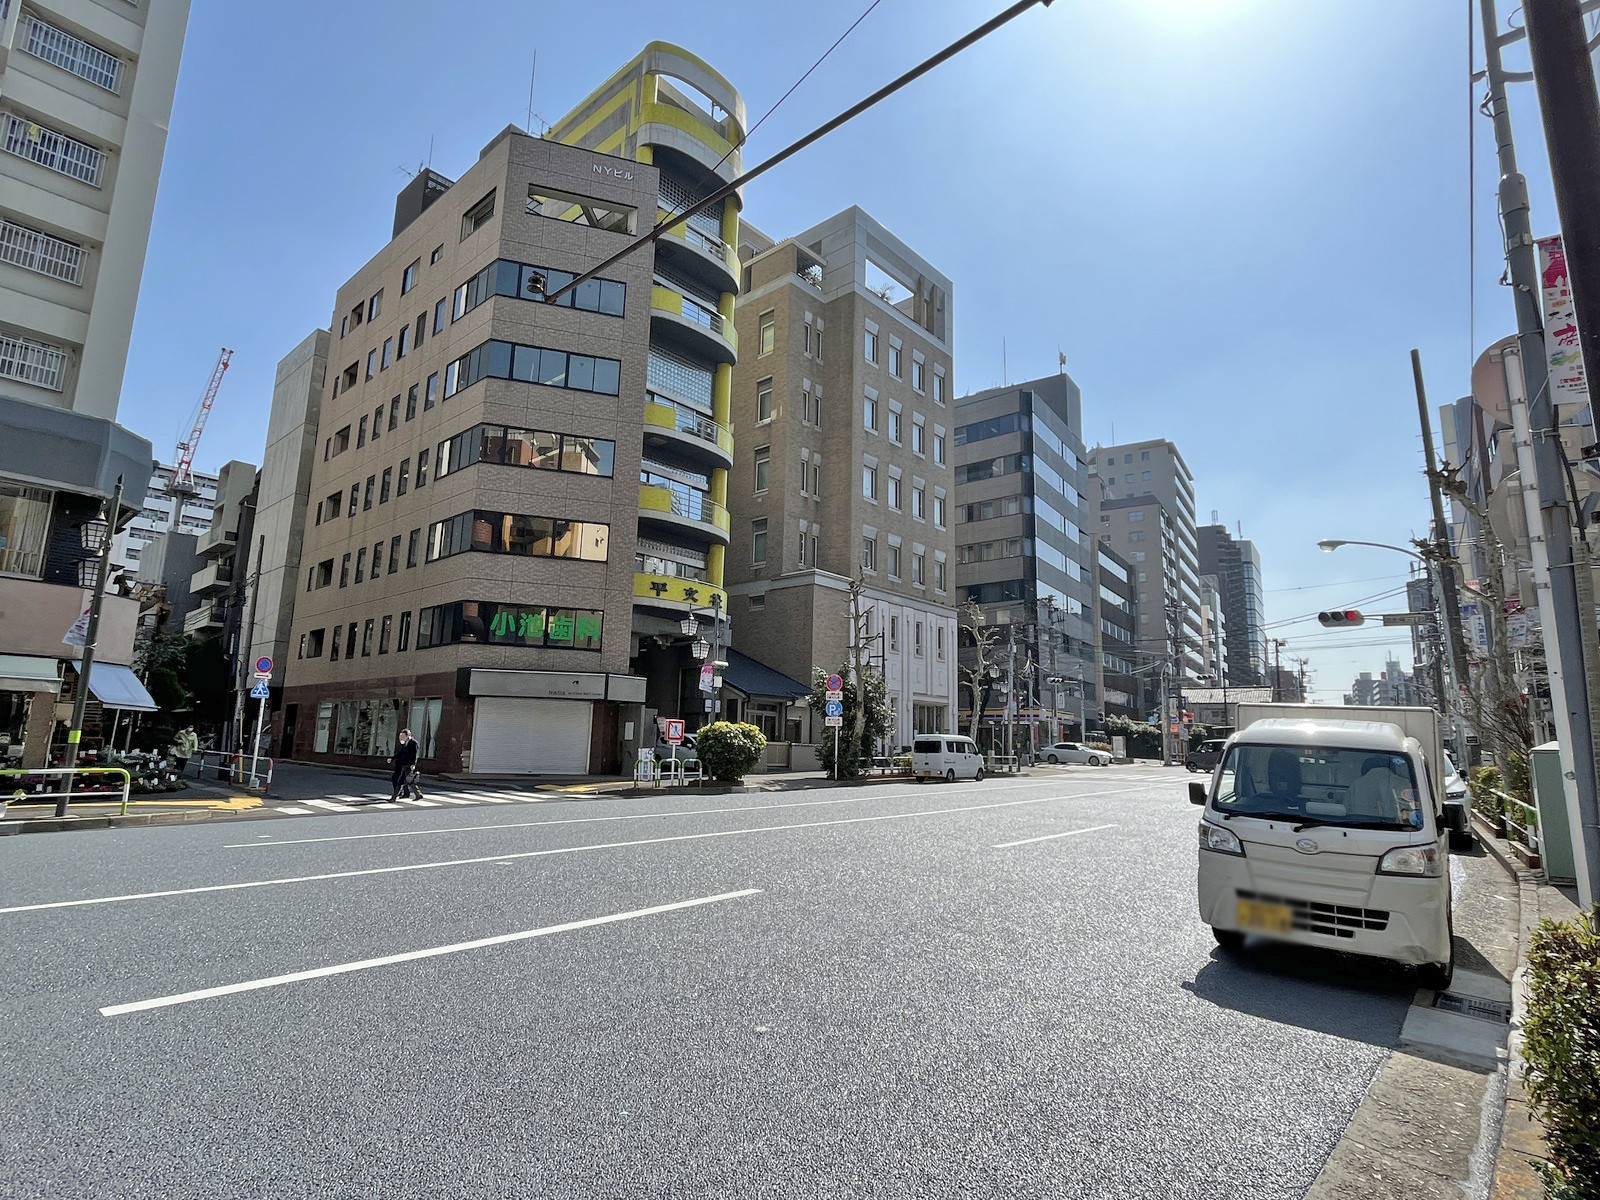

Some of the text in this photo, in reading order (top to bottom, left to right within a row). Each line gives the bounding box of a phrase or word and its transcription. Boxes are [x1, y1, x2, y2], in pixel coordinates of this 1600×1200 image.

[592, 163, 634, 180] NYビル
[490, 611, 601, 641] 小池歯科
